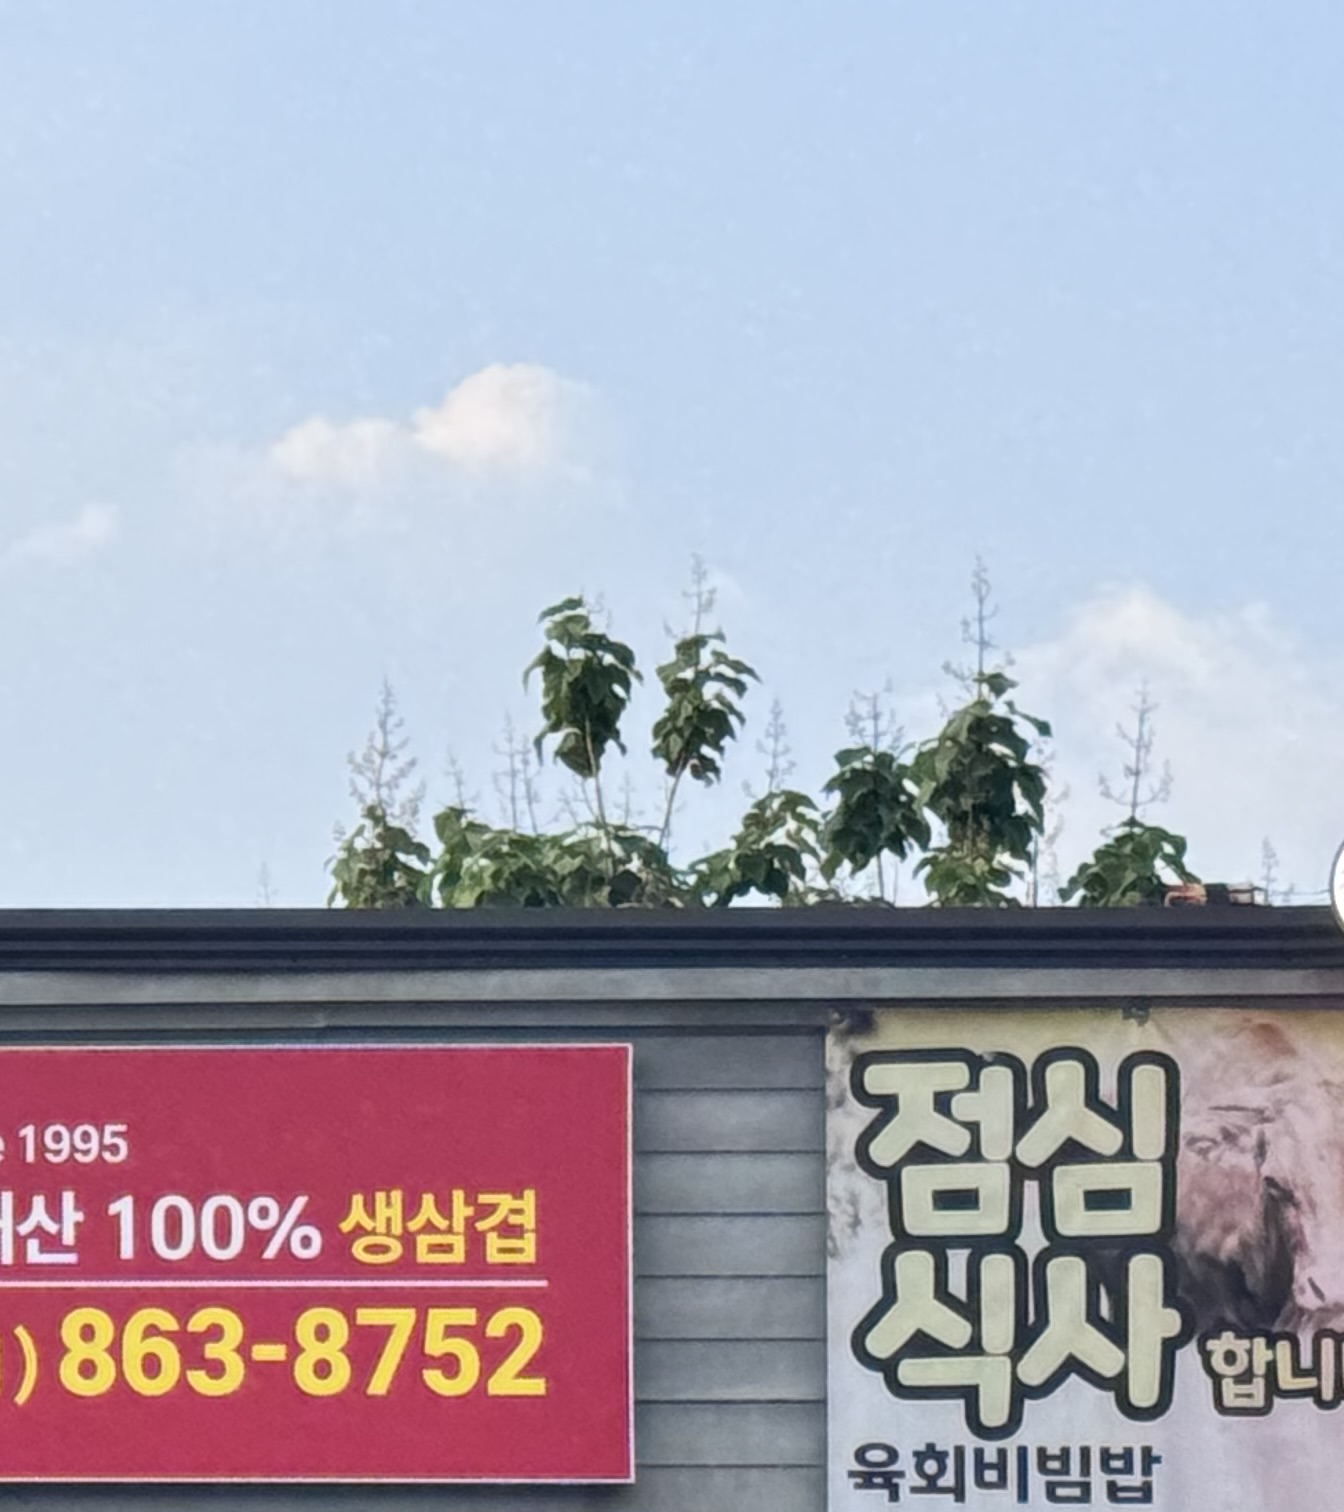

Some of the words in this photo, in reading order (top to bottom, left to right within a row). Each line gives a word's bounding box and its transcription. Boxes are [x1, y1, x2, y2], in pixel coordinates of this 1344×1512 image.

[17, 1123, 129, 1164] 1995
[850, 1046, 1180, 1244] 점심
[107, 1195, 323, 1263] 100%
[339, 1189, 538, 1265] 생삼겹
[58, 1306, 548, 1399] 863-8752
[851, 1242, 1196, 1441] 식사
[1198, 1329, 1344, 1418] 합니
[847, 1442, 1163, 1505] 육회비빔밥
